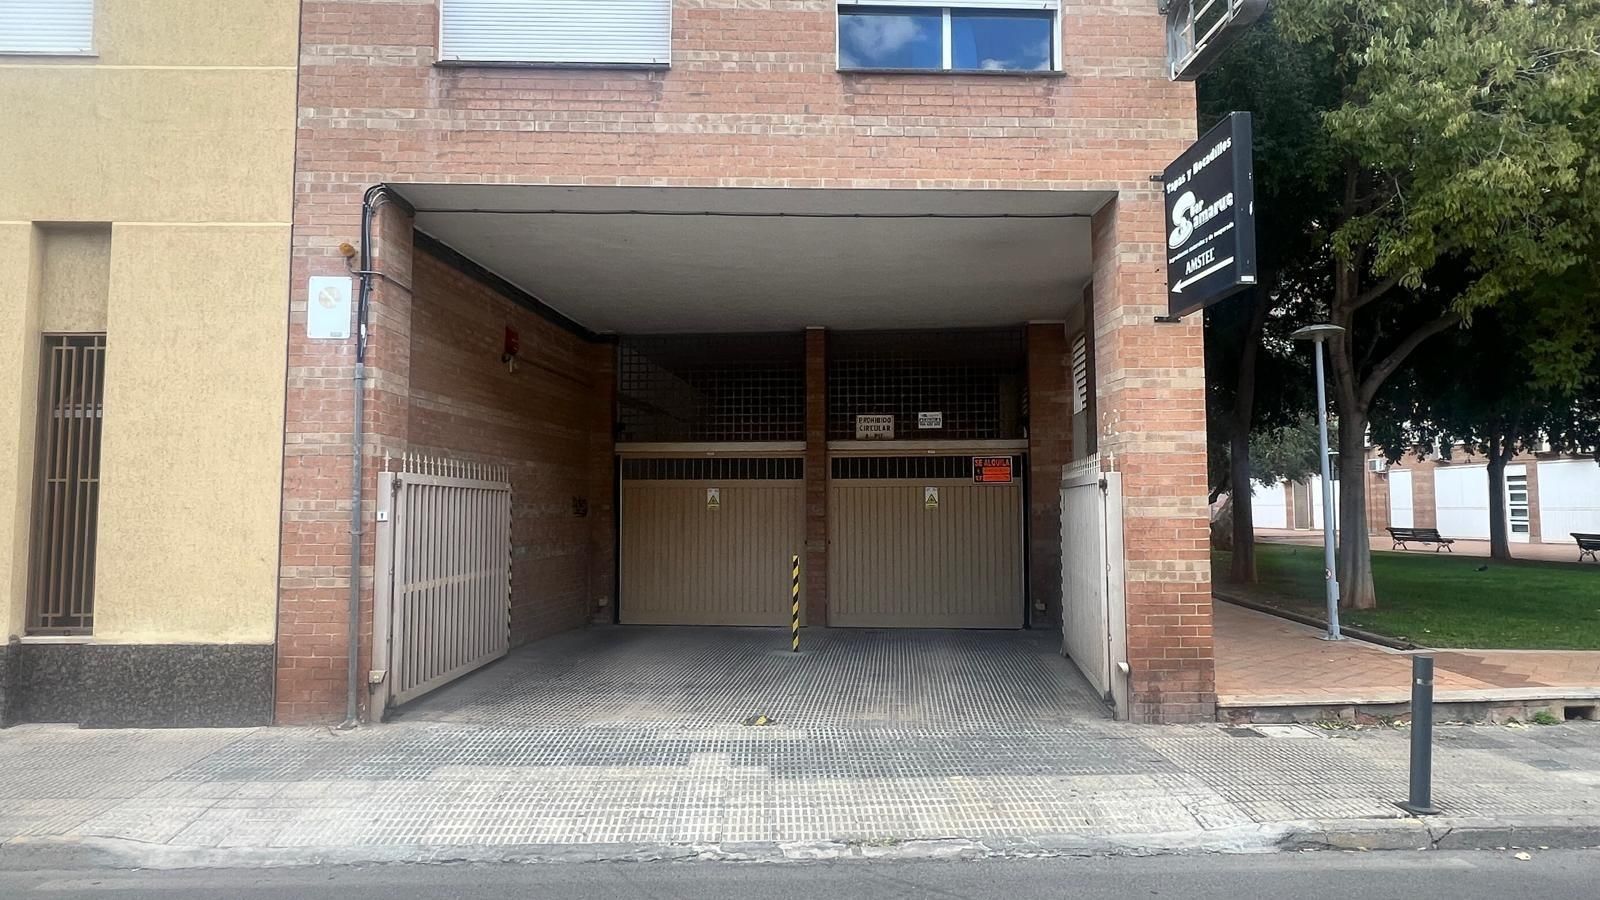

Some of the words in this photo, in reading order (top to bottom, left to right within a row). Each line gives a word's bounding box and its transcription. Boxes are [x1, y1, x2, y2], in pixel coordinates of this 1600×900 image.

[1193, 137, 1232, 175] Bocadillos
[1185, 247, 1215, 275] AMSTEL
[975, 459, 982, 467] SE
[984, 458, 1010, 467] ALQUILA
